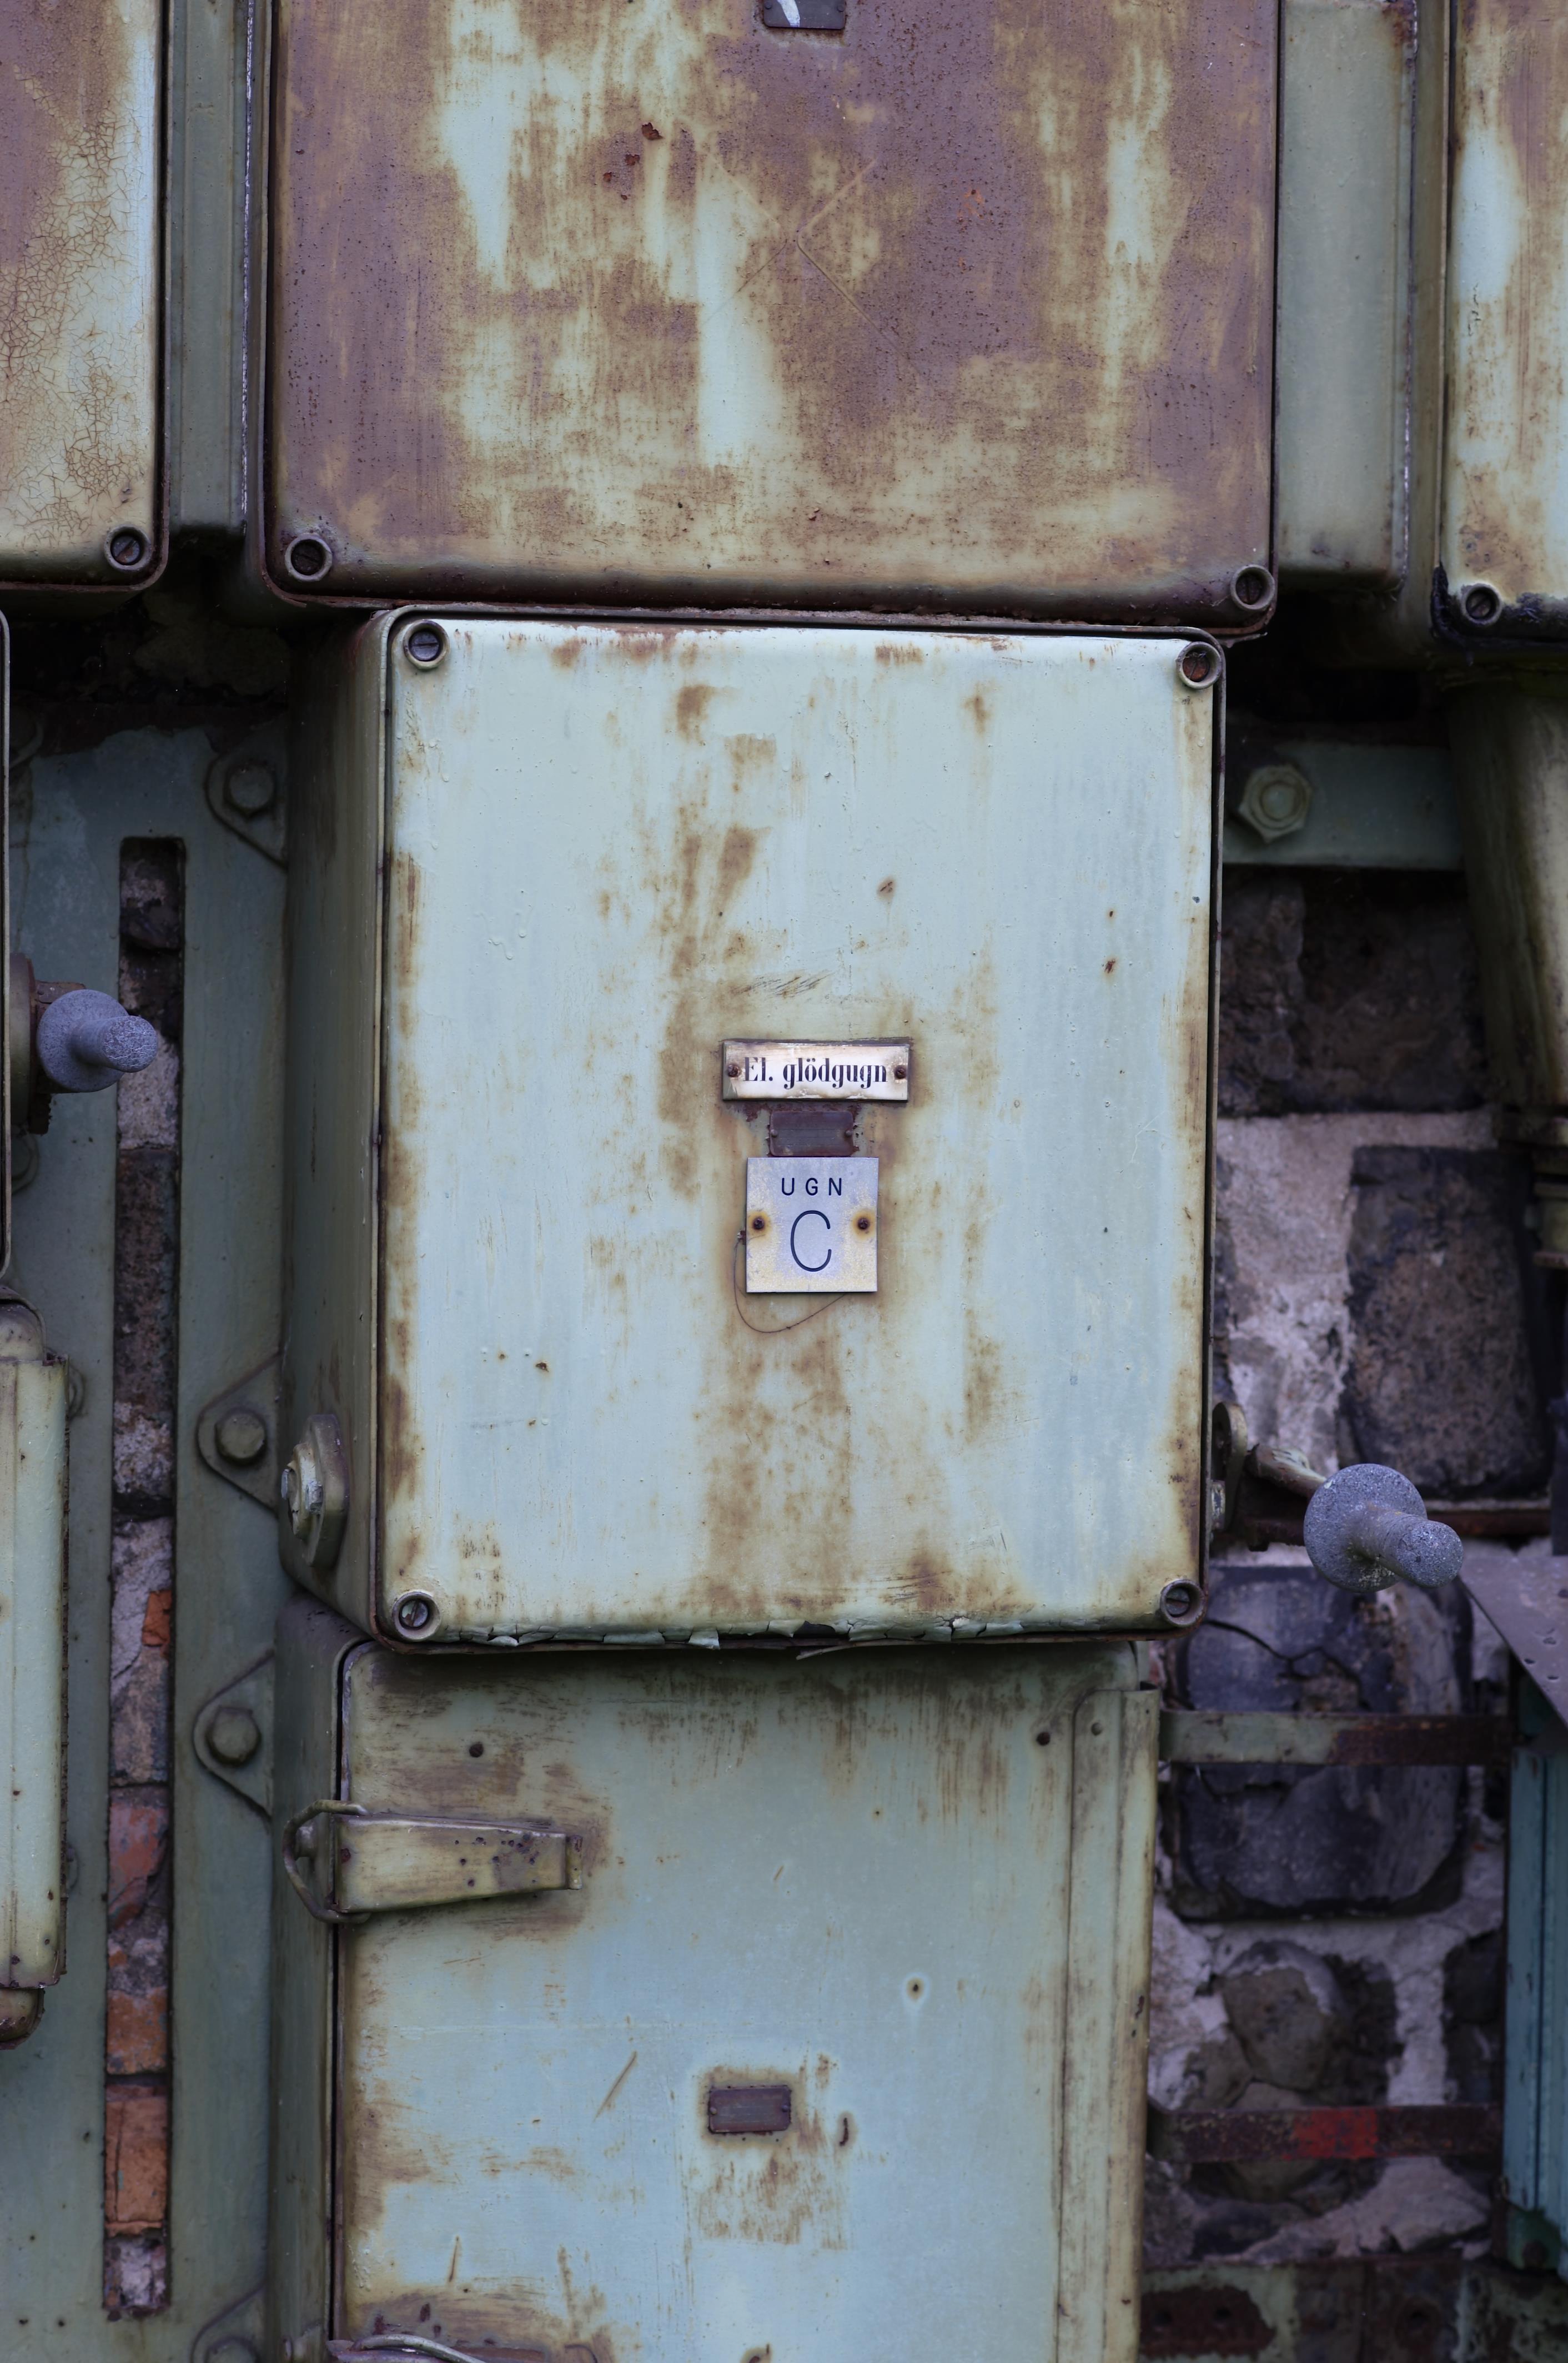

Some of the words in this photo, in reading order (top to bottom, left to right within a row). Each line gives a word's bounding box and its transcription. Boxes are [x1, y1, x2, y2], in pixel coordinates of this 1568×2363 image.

[743, 1057, 773, 1082] El.
[783, 1057, 888, 1089] glödgugn
[781, 1177, 842, 1196] UGN
[790, 1210, 832, 1272] C
